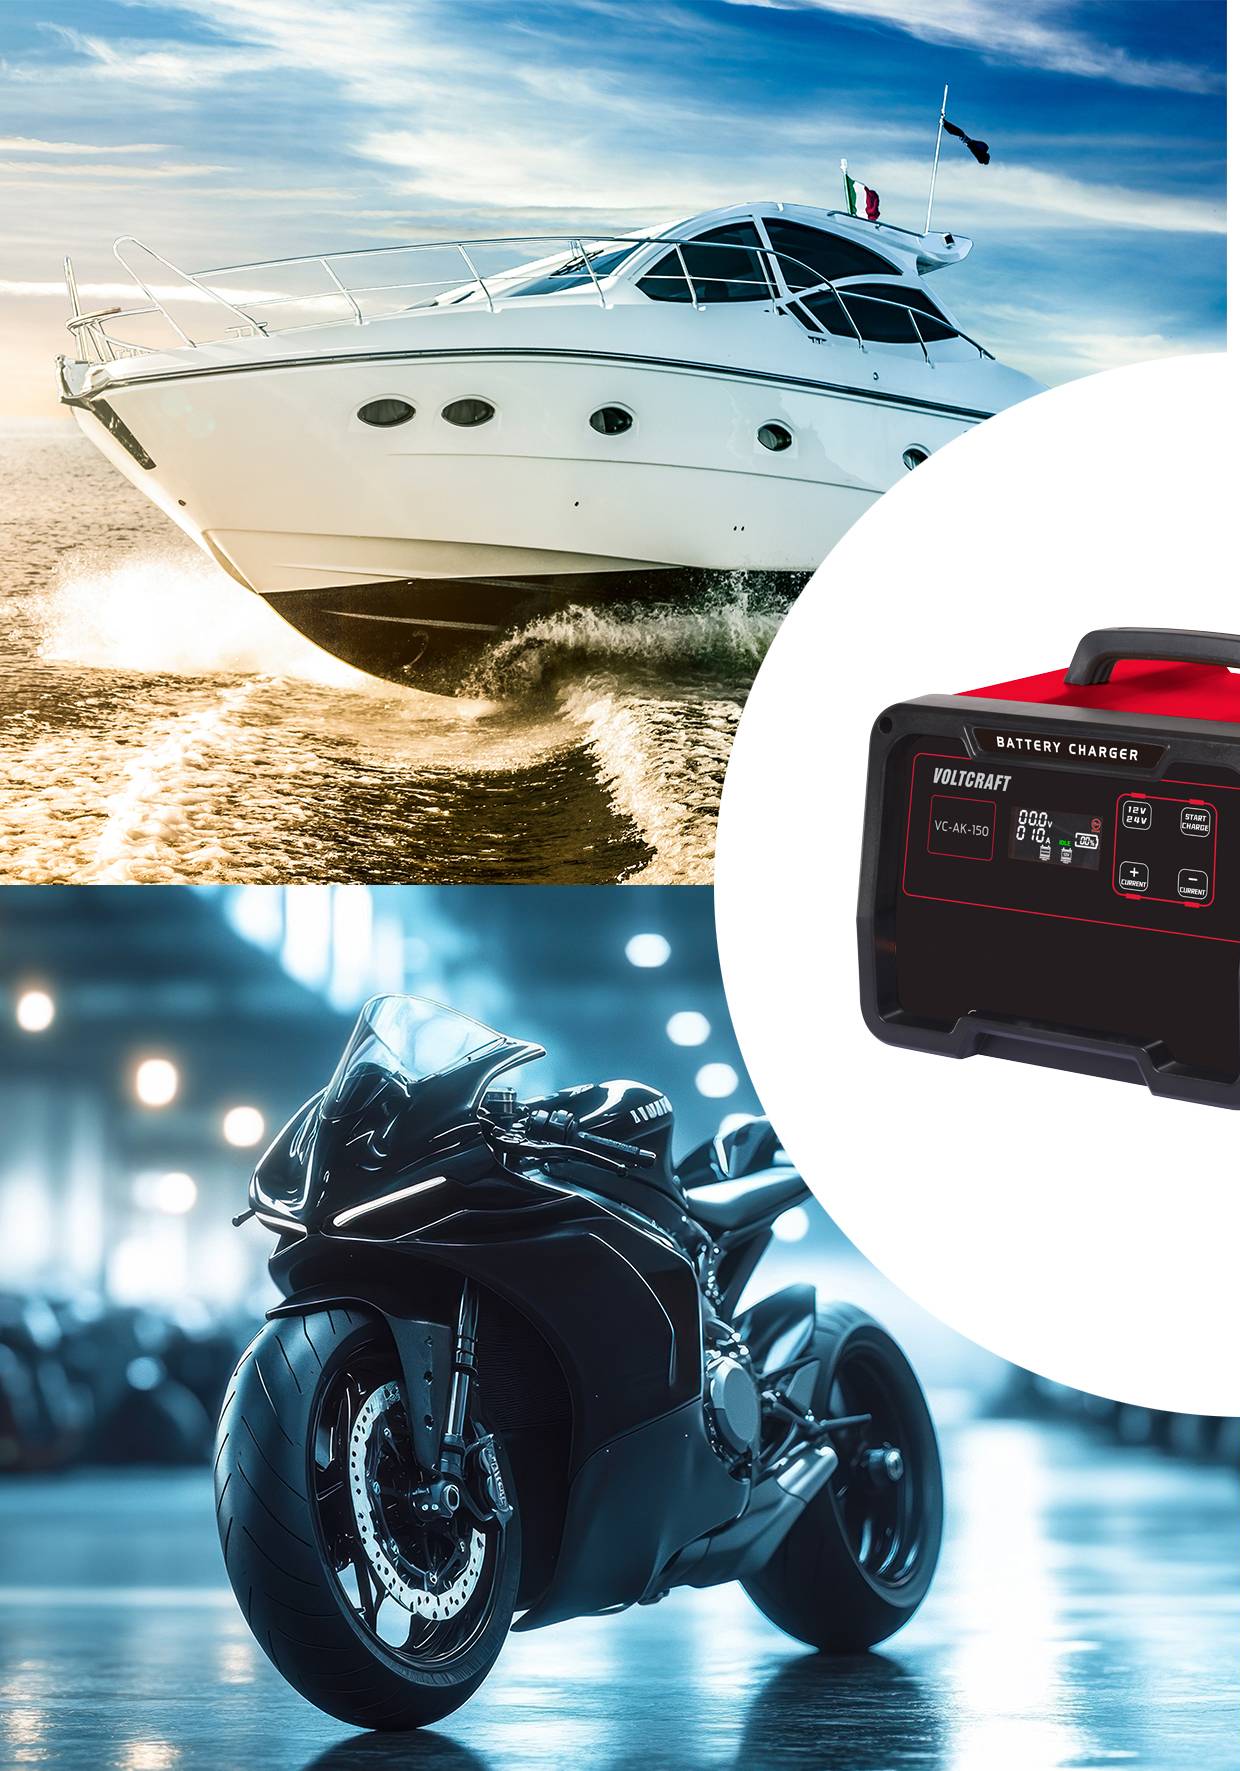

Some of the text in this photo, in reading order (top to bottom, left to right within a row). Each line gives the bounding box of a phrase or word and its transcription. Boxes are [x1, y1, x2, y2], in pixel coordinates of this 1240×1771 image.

[996, 736, 1139, 761] BATTERY CHARGER
[933, 767, 1012, 792] VOLTCRAFT
[1128, 805, 1147, 815] 12V
[1126, 815, 1148, 825] 24V
[1184, 813, 1207, 822] START
[934, 819, 990, 837] VC-AK-150
[1181, 822, 1209, 832] CHARGE
[1120, 878, 1147, 888] CURRENT
[1179, 886, 1206, 896] CURRENT
